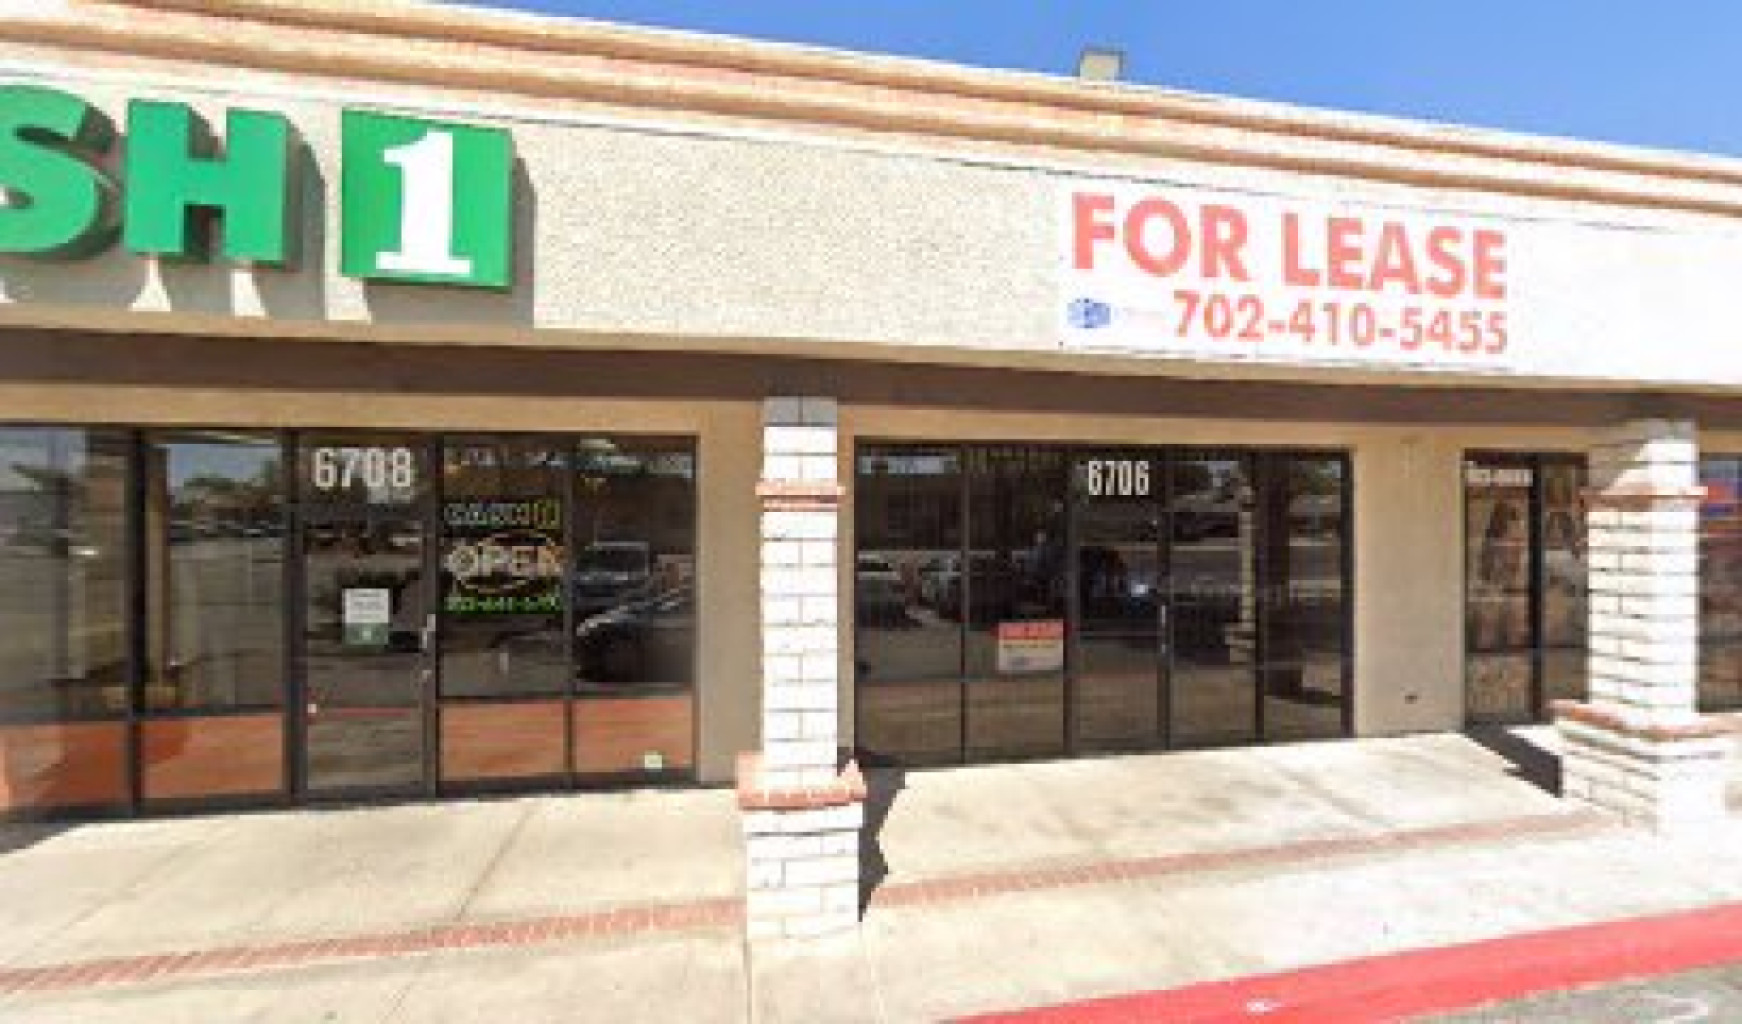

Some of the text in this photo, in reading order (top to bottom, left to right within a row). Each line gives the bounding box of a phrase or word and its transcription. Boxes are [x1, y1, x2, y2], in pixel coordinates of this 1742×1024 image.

[376, 129, 473, 275] 1
[1072, 191, 1508, 300] FOR LEASE
[1173, 290, 1509, 355] 702-410-5455
[313, 446, 412, 490] 6708
[1087, 459, 1150, 496] 6706
